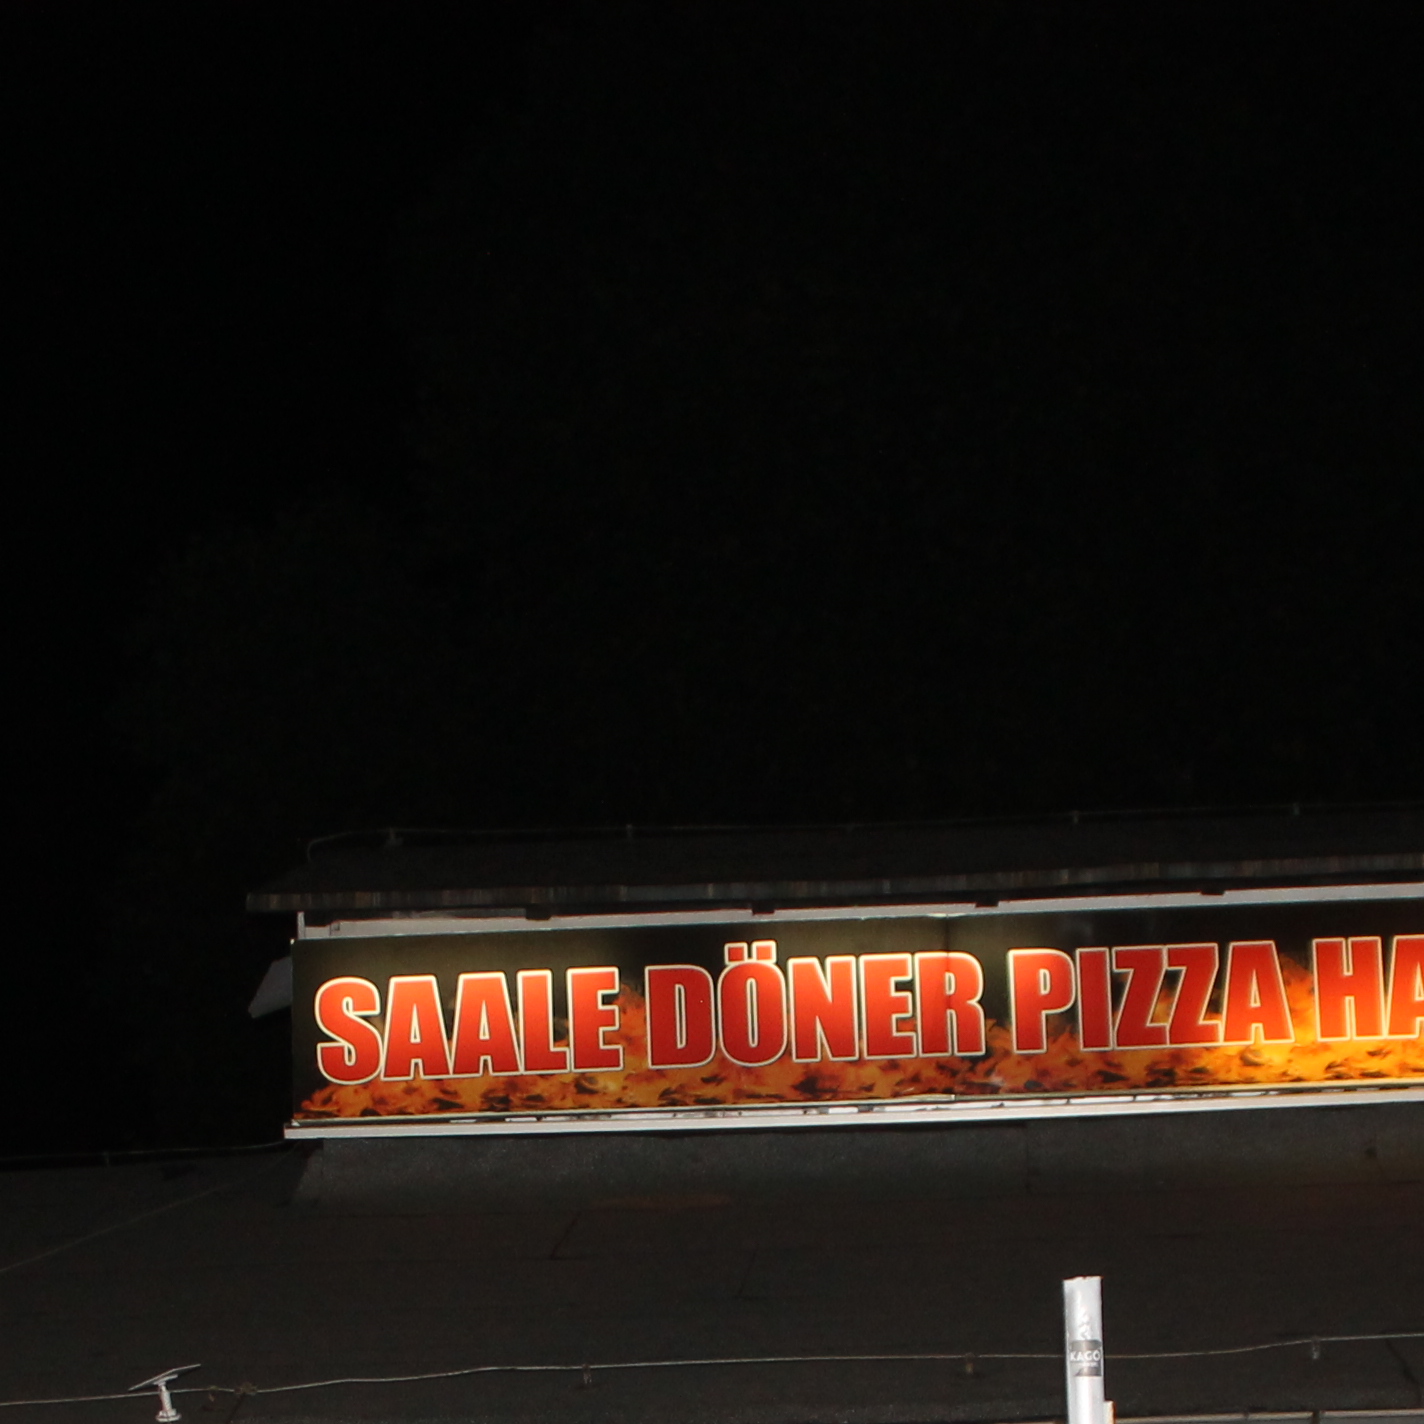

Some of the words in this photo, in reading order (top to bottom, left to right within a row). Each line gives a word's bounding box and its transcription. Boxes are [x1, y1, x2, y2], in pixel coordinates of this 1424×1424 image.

[314, 966, 624, 1085] SAALE
[644, 940, 986, 1069] DÖNER
[1006, 939, 1294, 1054] PIZZA
